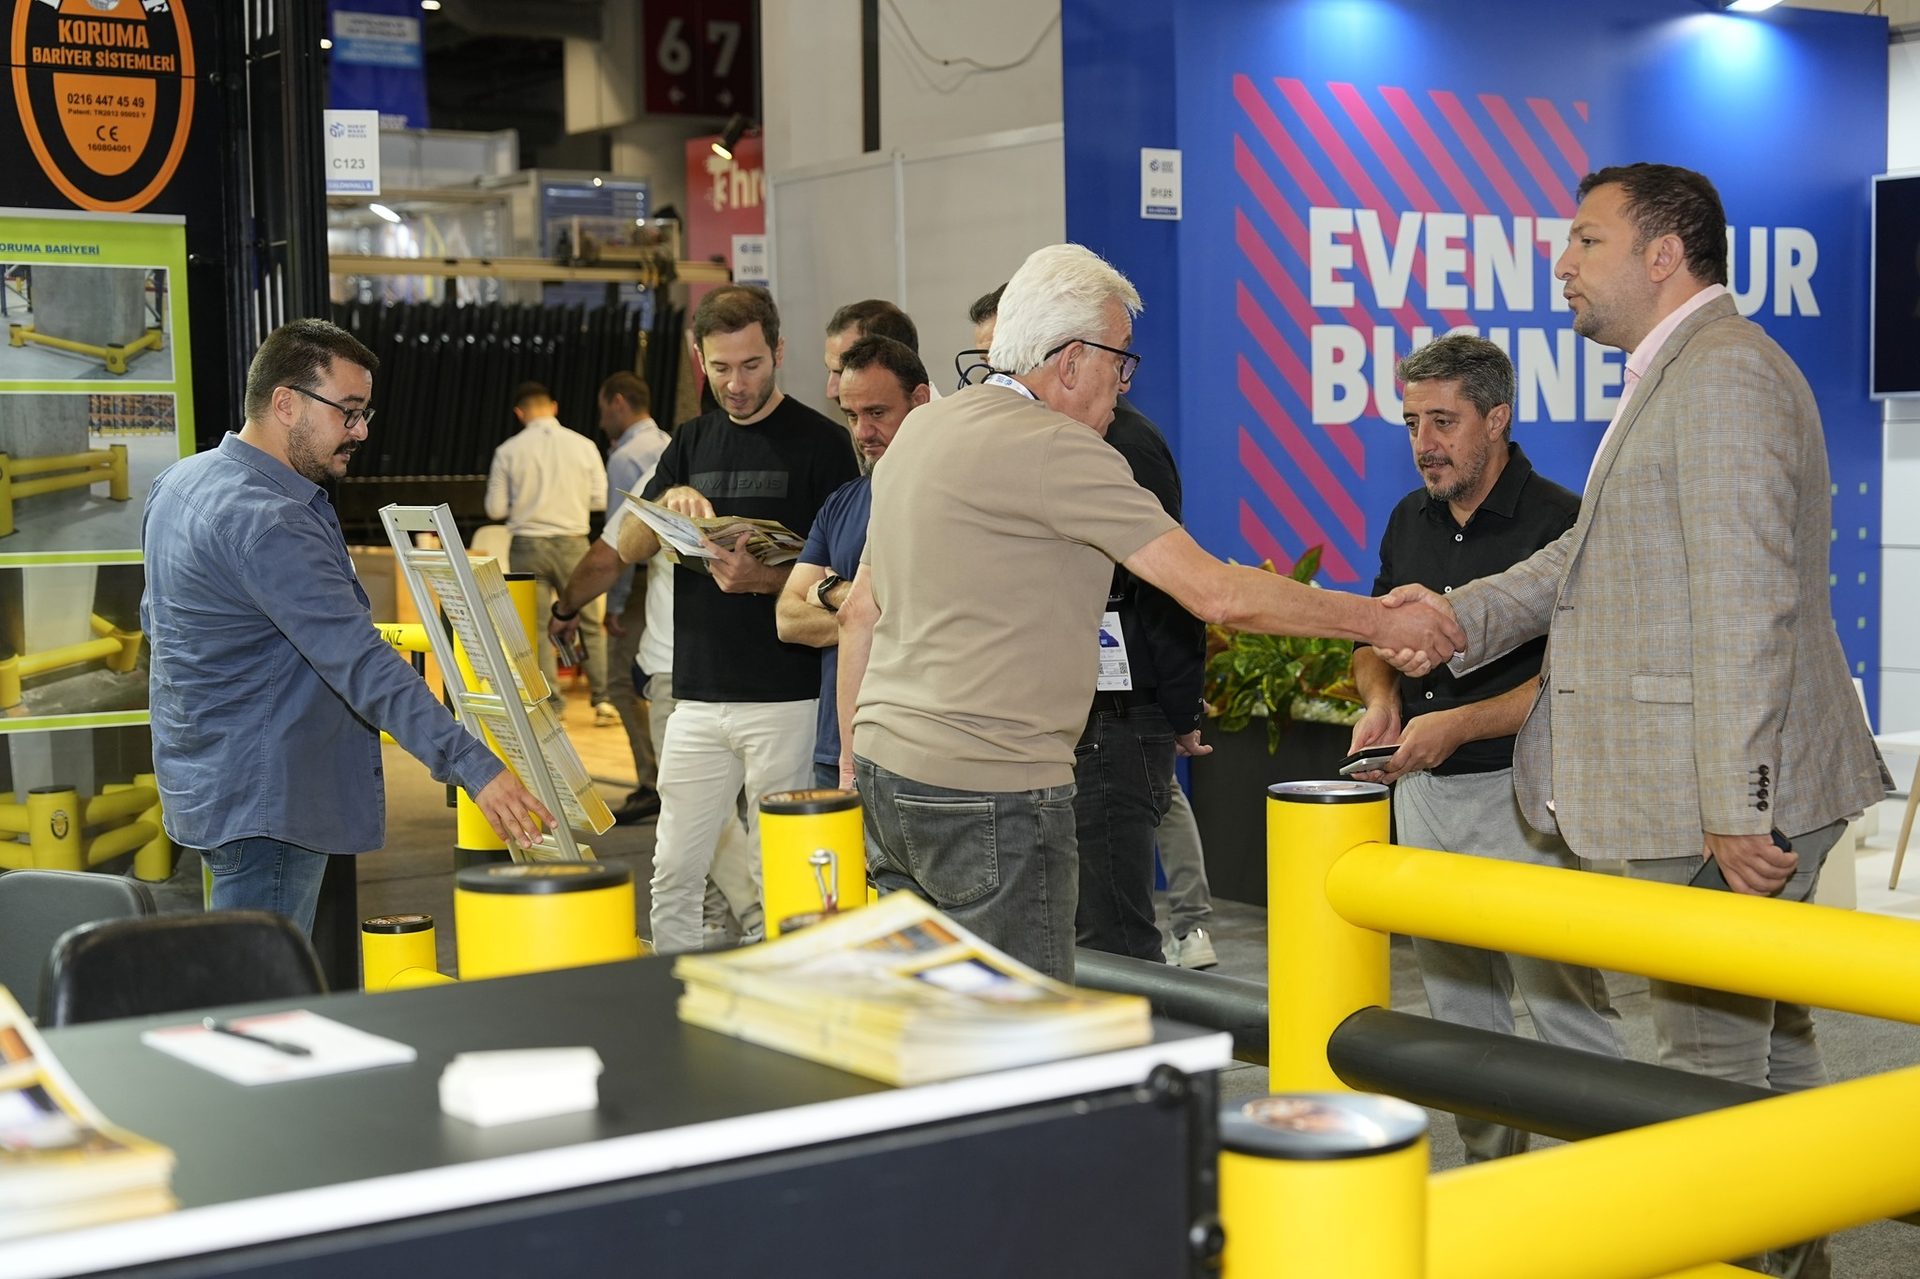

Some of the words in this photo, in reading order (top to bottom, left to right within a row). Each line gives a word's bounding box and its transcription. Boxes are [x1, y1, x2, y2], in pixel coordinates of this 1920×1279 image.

[58, 19, 150, 48] KORUMA
[657, 18, 691, 74] 6
[707, 20, 740, 77] 7
[32, 46, 92, 68] BARİYER
[95, 50, 176, 72] SİSTEMLERİ
[67, 93, 92, 105] 0216
[95, 95, 113, 107] 447
[117, 96, 129, 108] 45
[132, 97, 144, 109] 49
[87, 143, 131, 153] 160804001
[332, 158, 366, 169] C123
[45, 243, 100, 255] BARİYERİ
[1309, 206, 1578, 312] EVENT
[1725, 225, 1822, 318] UR
